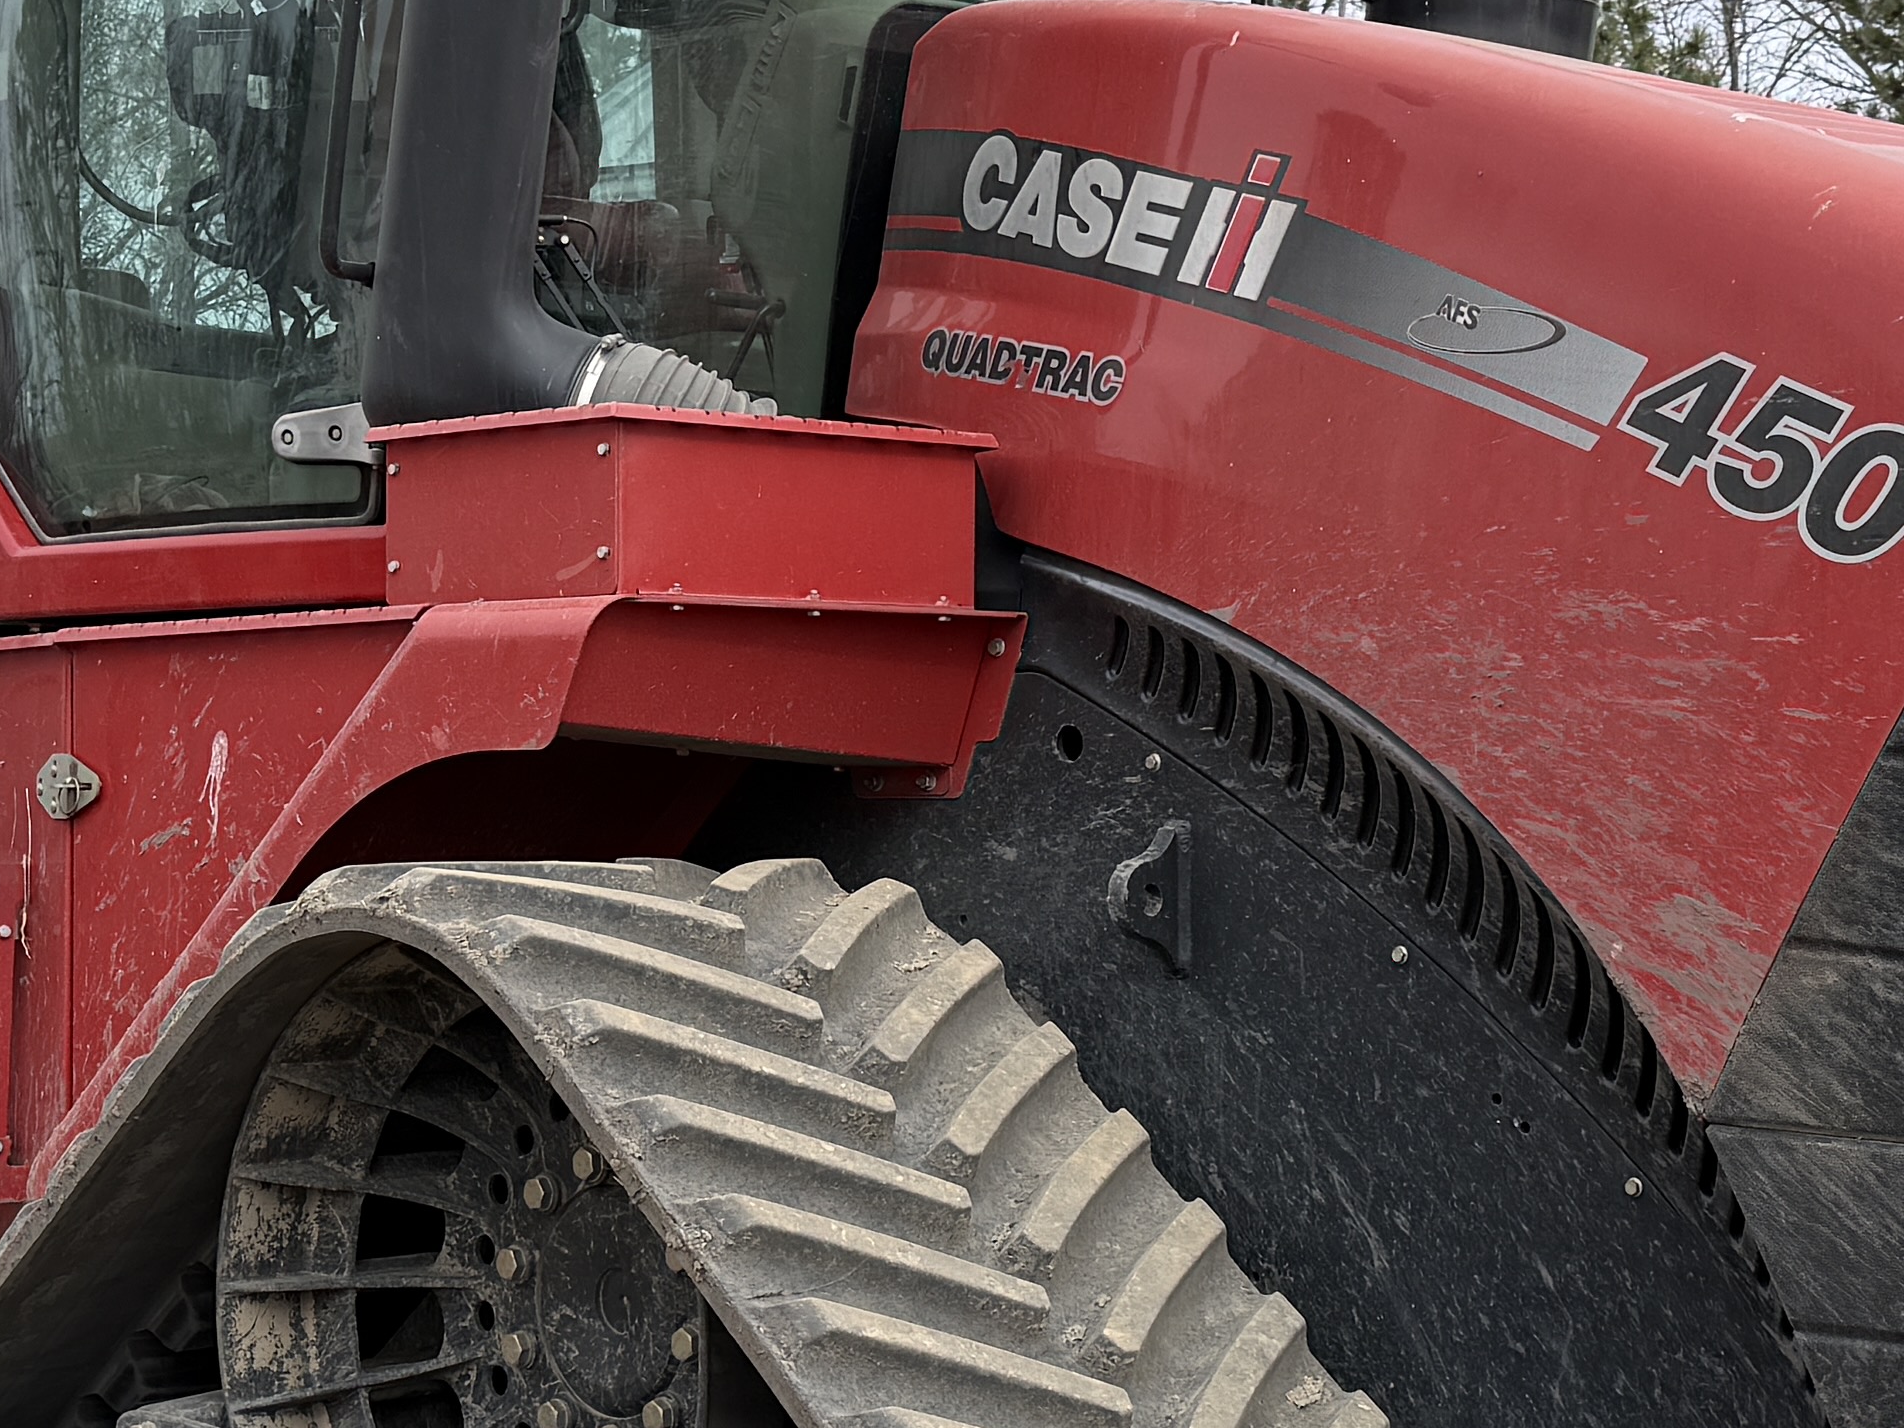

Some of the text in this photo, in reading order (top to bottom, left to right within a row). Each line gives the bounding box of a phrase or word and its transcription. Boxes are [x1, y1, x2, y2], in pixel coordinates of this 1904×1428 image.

[962, 135, 1194, 276] CASE
[1436, 293, 1481, 330] AFS
[921, 327, 1126, 407] QUADTRAC
